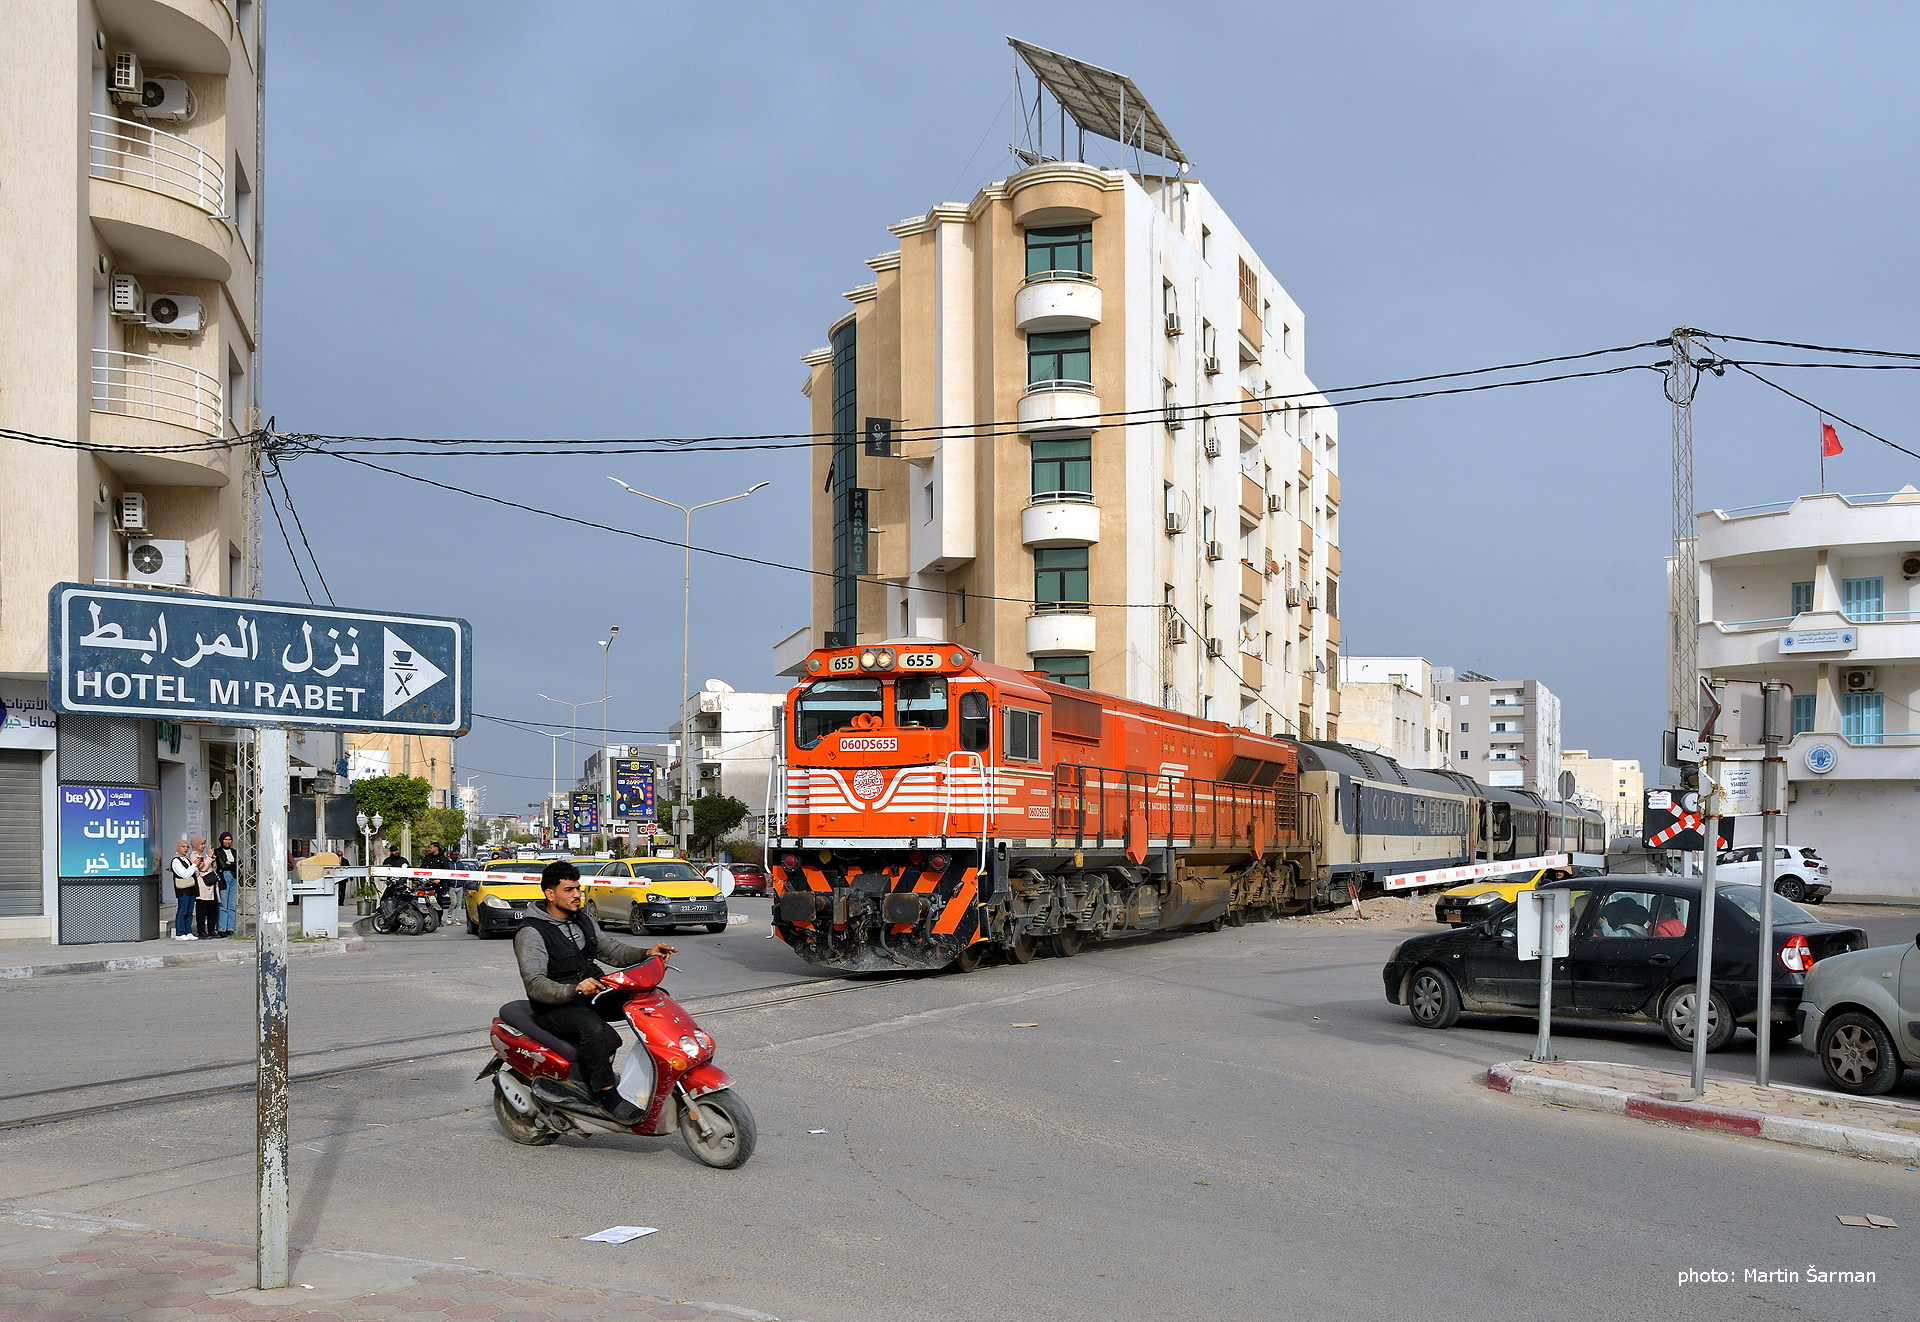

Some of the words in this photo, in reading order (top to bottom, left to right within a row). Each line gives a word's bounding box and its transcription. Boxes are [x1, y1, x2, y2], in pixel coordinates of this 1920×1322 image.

[853, 491, 864, 571] PHARMACIE
[80, 601, 258, 667] المرابط
[282, 620, 359, 677] نزل
[906, 654, 934, 667] 655
[834, 657, 854, 670] 655
[77, 670, 196, 703] HOTEL
[210, 678, 366, 713] M'RABET
[841, 739, 896, 750] 060DS655
[65, 791, 84, 804] bee
